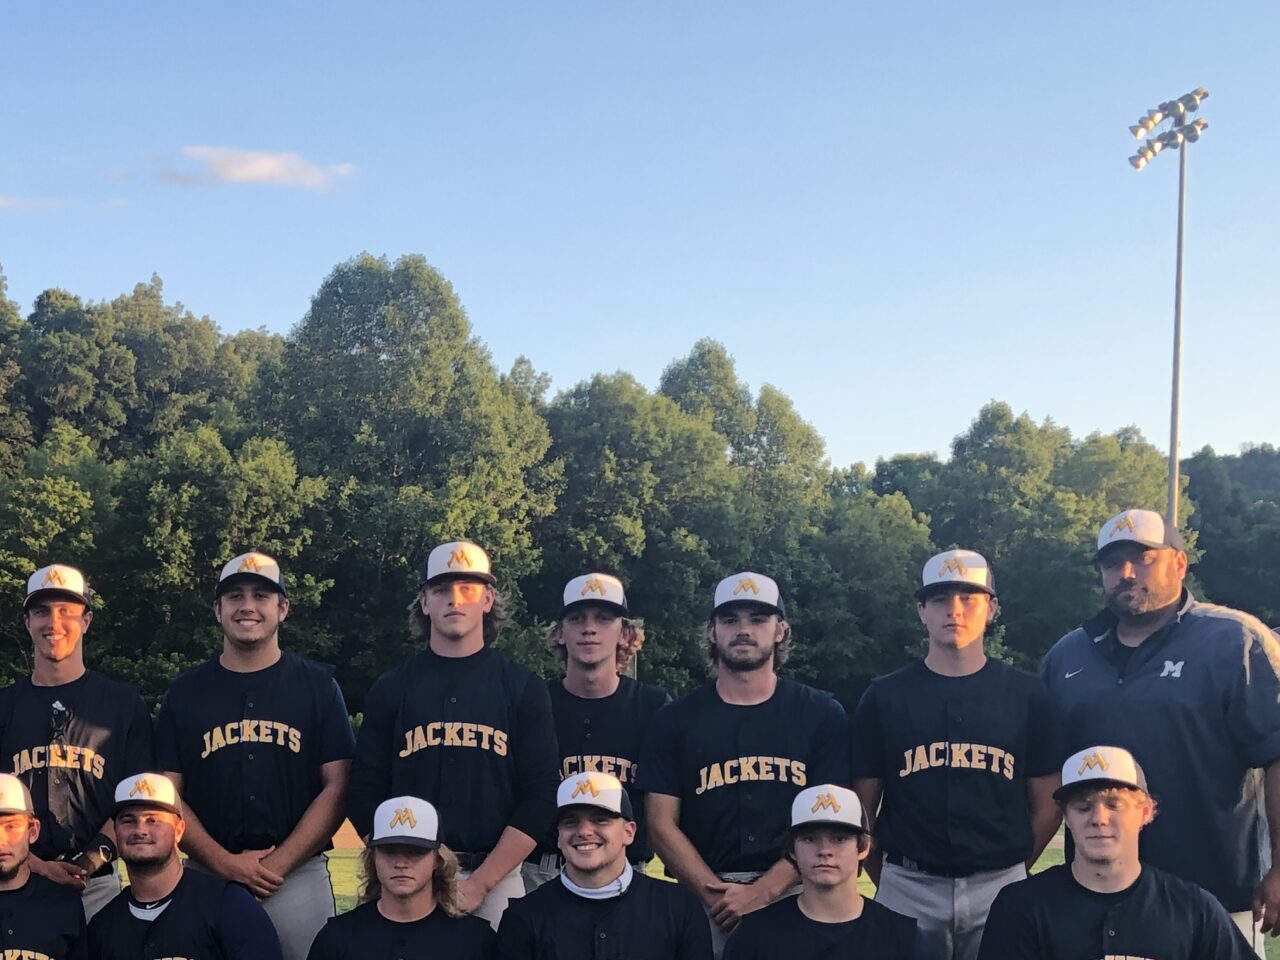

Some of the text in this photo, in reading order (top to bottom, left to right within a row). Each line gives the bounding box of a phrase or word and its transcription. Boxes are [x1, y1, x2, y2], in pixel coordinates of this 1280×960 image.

[1110, 515, 1138, 537] M
[237, 555, 262, 573] M
[448, 548, 473, 569] M
[938, 557, 968, 578] M
[42, 569, 66, 587] M
[581, 579, 607, 597] M
[733, 578, 760, 595] M
[1160, 660, 1184, 677] M
[201, 720, 301, 759] JACKETS
[399, 721, 508, 757] JACKETS
[10, 744, 105, 780] JACKETS
[899, 742, 1014, 780] JACKETS
[1078, 752, 1109, 775] M
[696, 756, 807, 795] JACKETS
[130, 778, 155, 797] M
[571, 778, 600, 798] M
[811, 793, 841, 813] M
[389, 808, 417, 829] M
